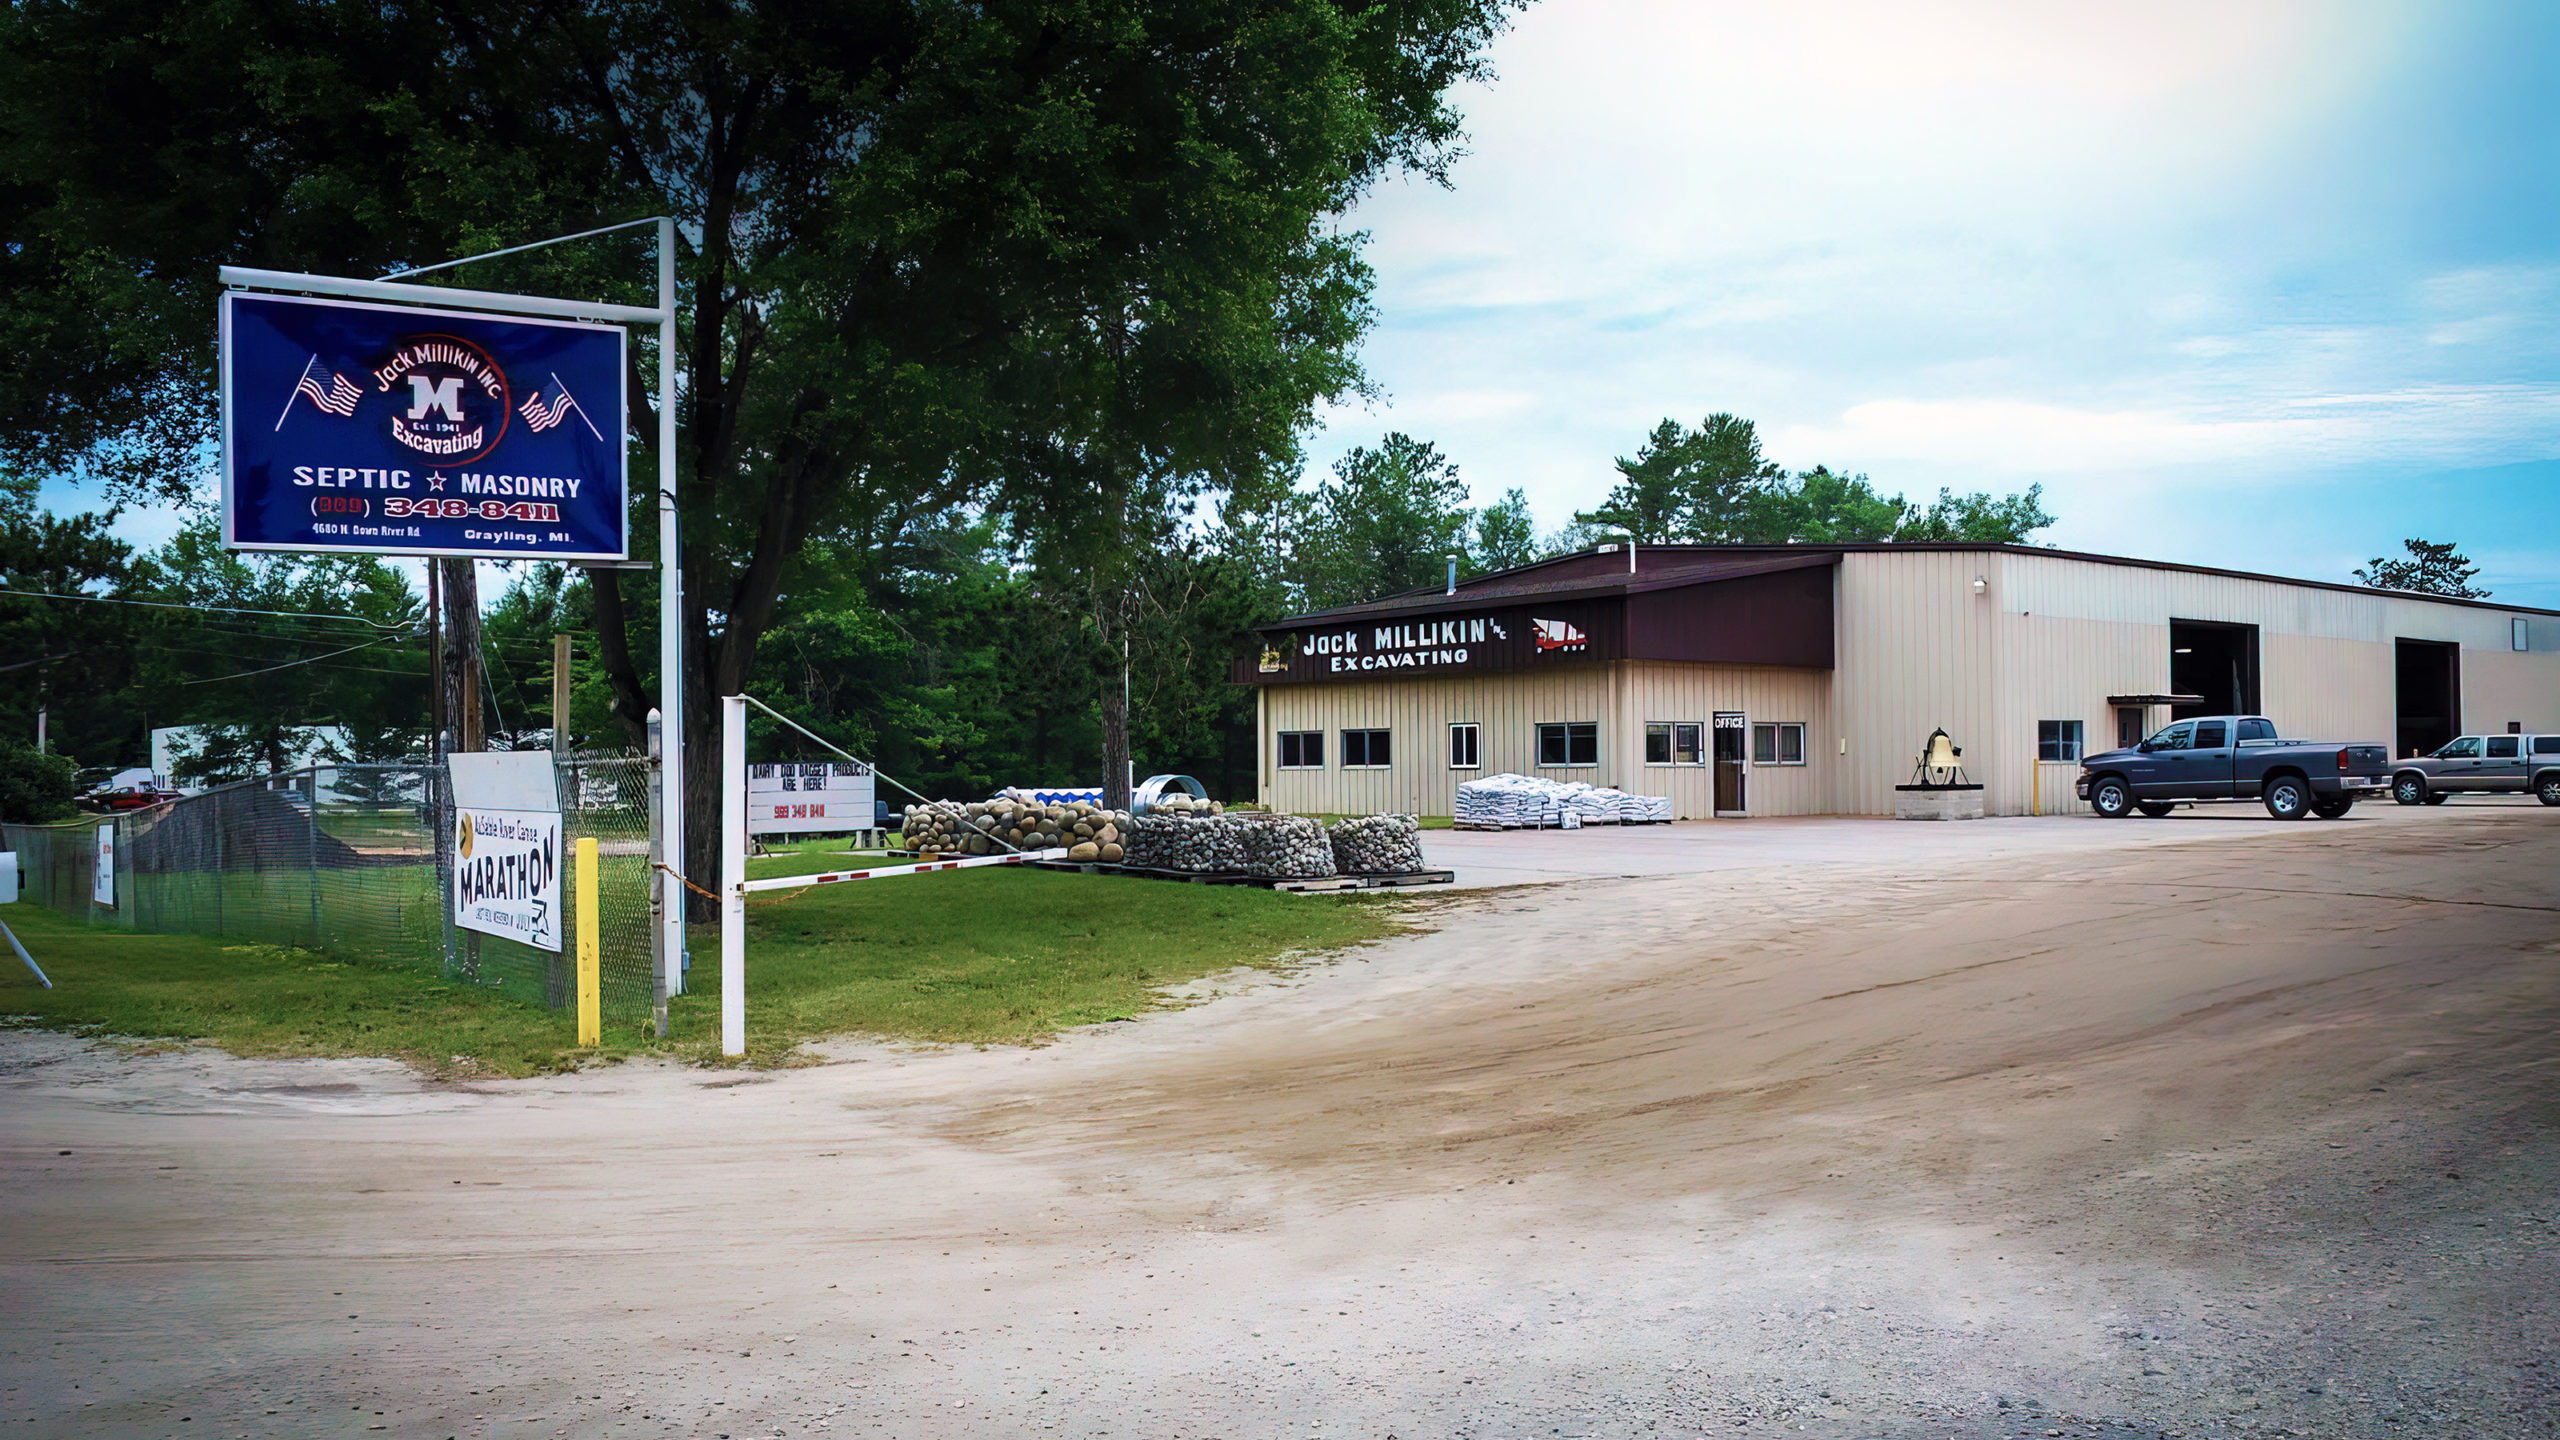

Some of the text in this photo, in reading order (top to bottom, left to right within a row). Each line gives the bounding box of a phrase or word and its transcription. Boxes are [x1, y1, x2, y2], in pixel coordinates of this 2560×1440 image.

[374, 352, 415, 392] Jack
[407, 375, 465, 421] M
[392, 415, 483, 454] Excavating
[292, 465, 581, 498] SEPTIC MASONRY
[384, 497, 560, 522] 348-8411
[1303, 631, 1358, 656] Jack
[1375, 618, 1486, 650] MILLIKIN
[1331, 648, 1469, 673] EXCAVATING
[1714, 717, 1744, 729] OFFICE
[782, 778, 797, 791] ARE
[460, 824, 555, 912] MARATHON
